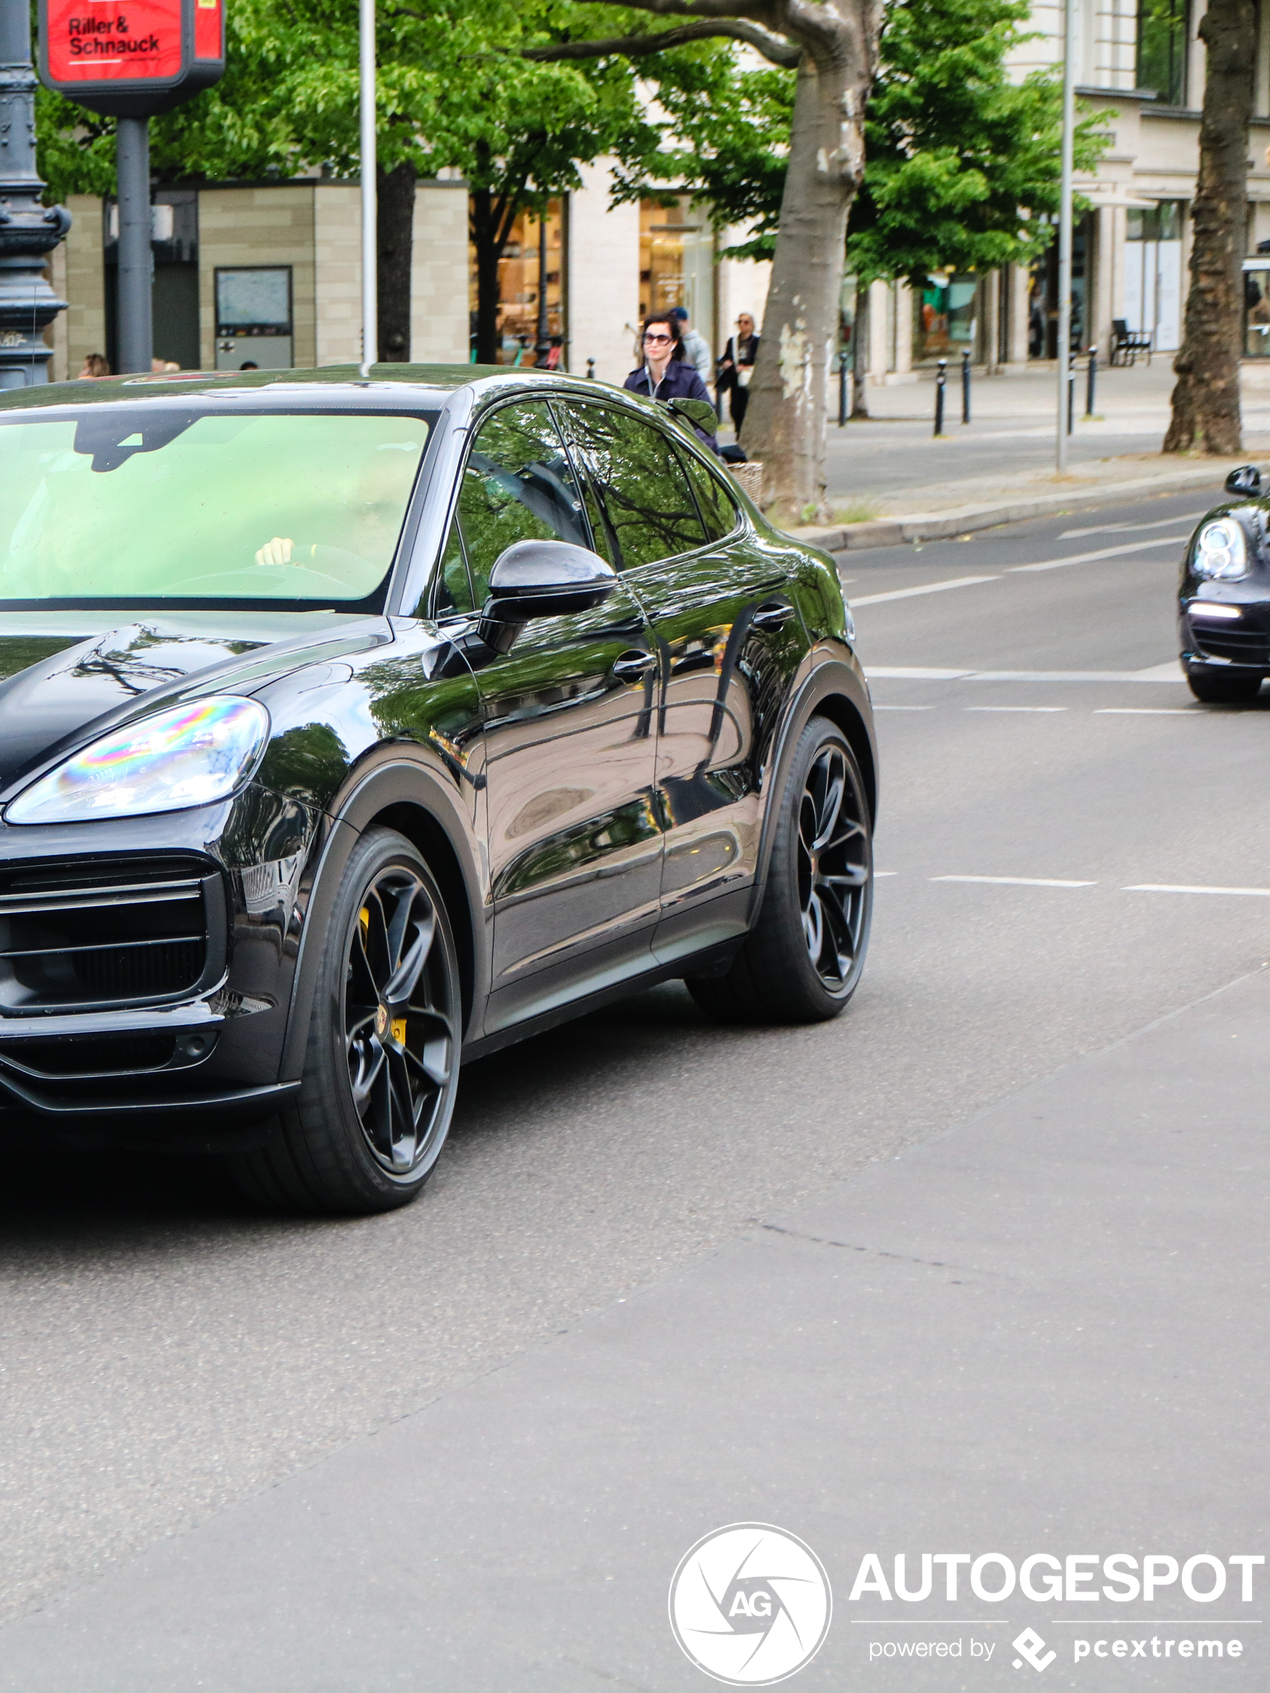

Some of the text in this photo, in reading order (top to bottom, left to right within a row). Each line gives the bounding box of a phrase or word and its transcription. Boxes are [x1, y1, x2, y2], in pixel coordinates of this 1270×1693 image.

[68, 16, 129, 35] Riller &
[69, 34, 160, 55] Schnauck
